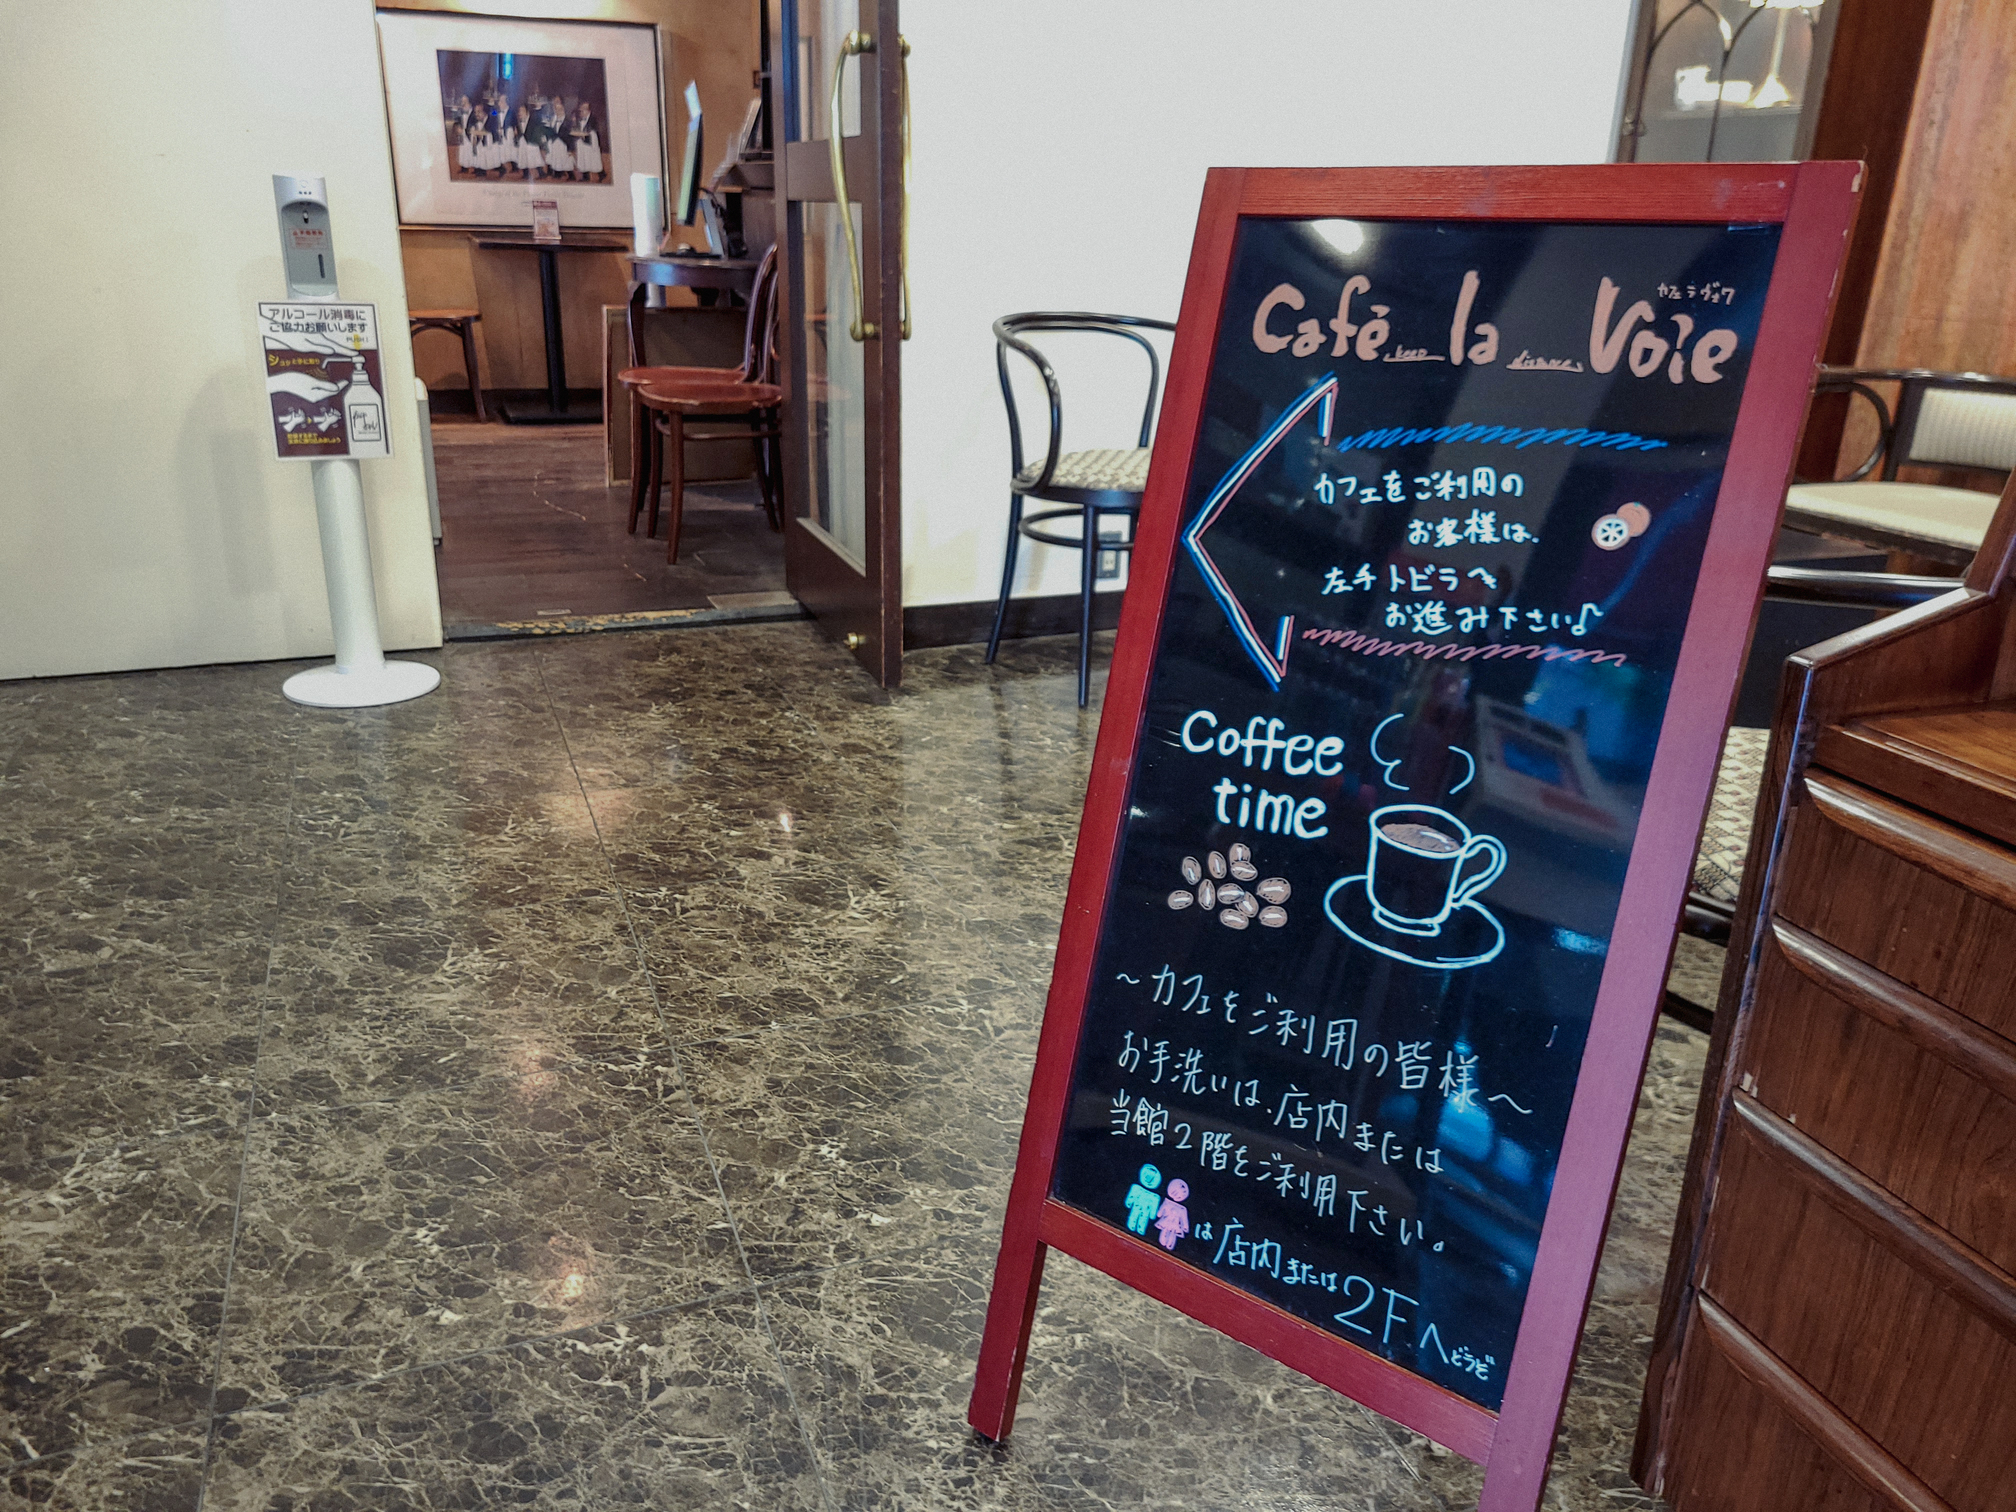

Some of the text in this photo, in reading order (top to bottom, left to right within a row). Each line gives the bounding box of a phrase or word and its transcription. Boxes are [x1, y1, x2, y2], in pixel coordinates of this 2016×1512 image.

[1450, 270, 1499, 366] la
[1589, 276, 1738, 384] Voie
[1314, 466, 1524, 504] カフェをご利用の
[1180, 709, 1345, 776] Coffee
[1213, 777, 1328, 839] time
